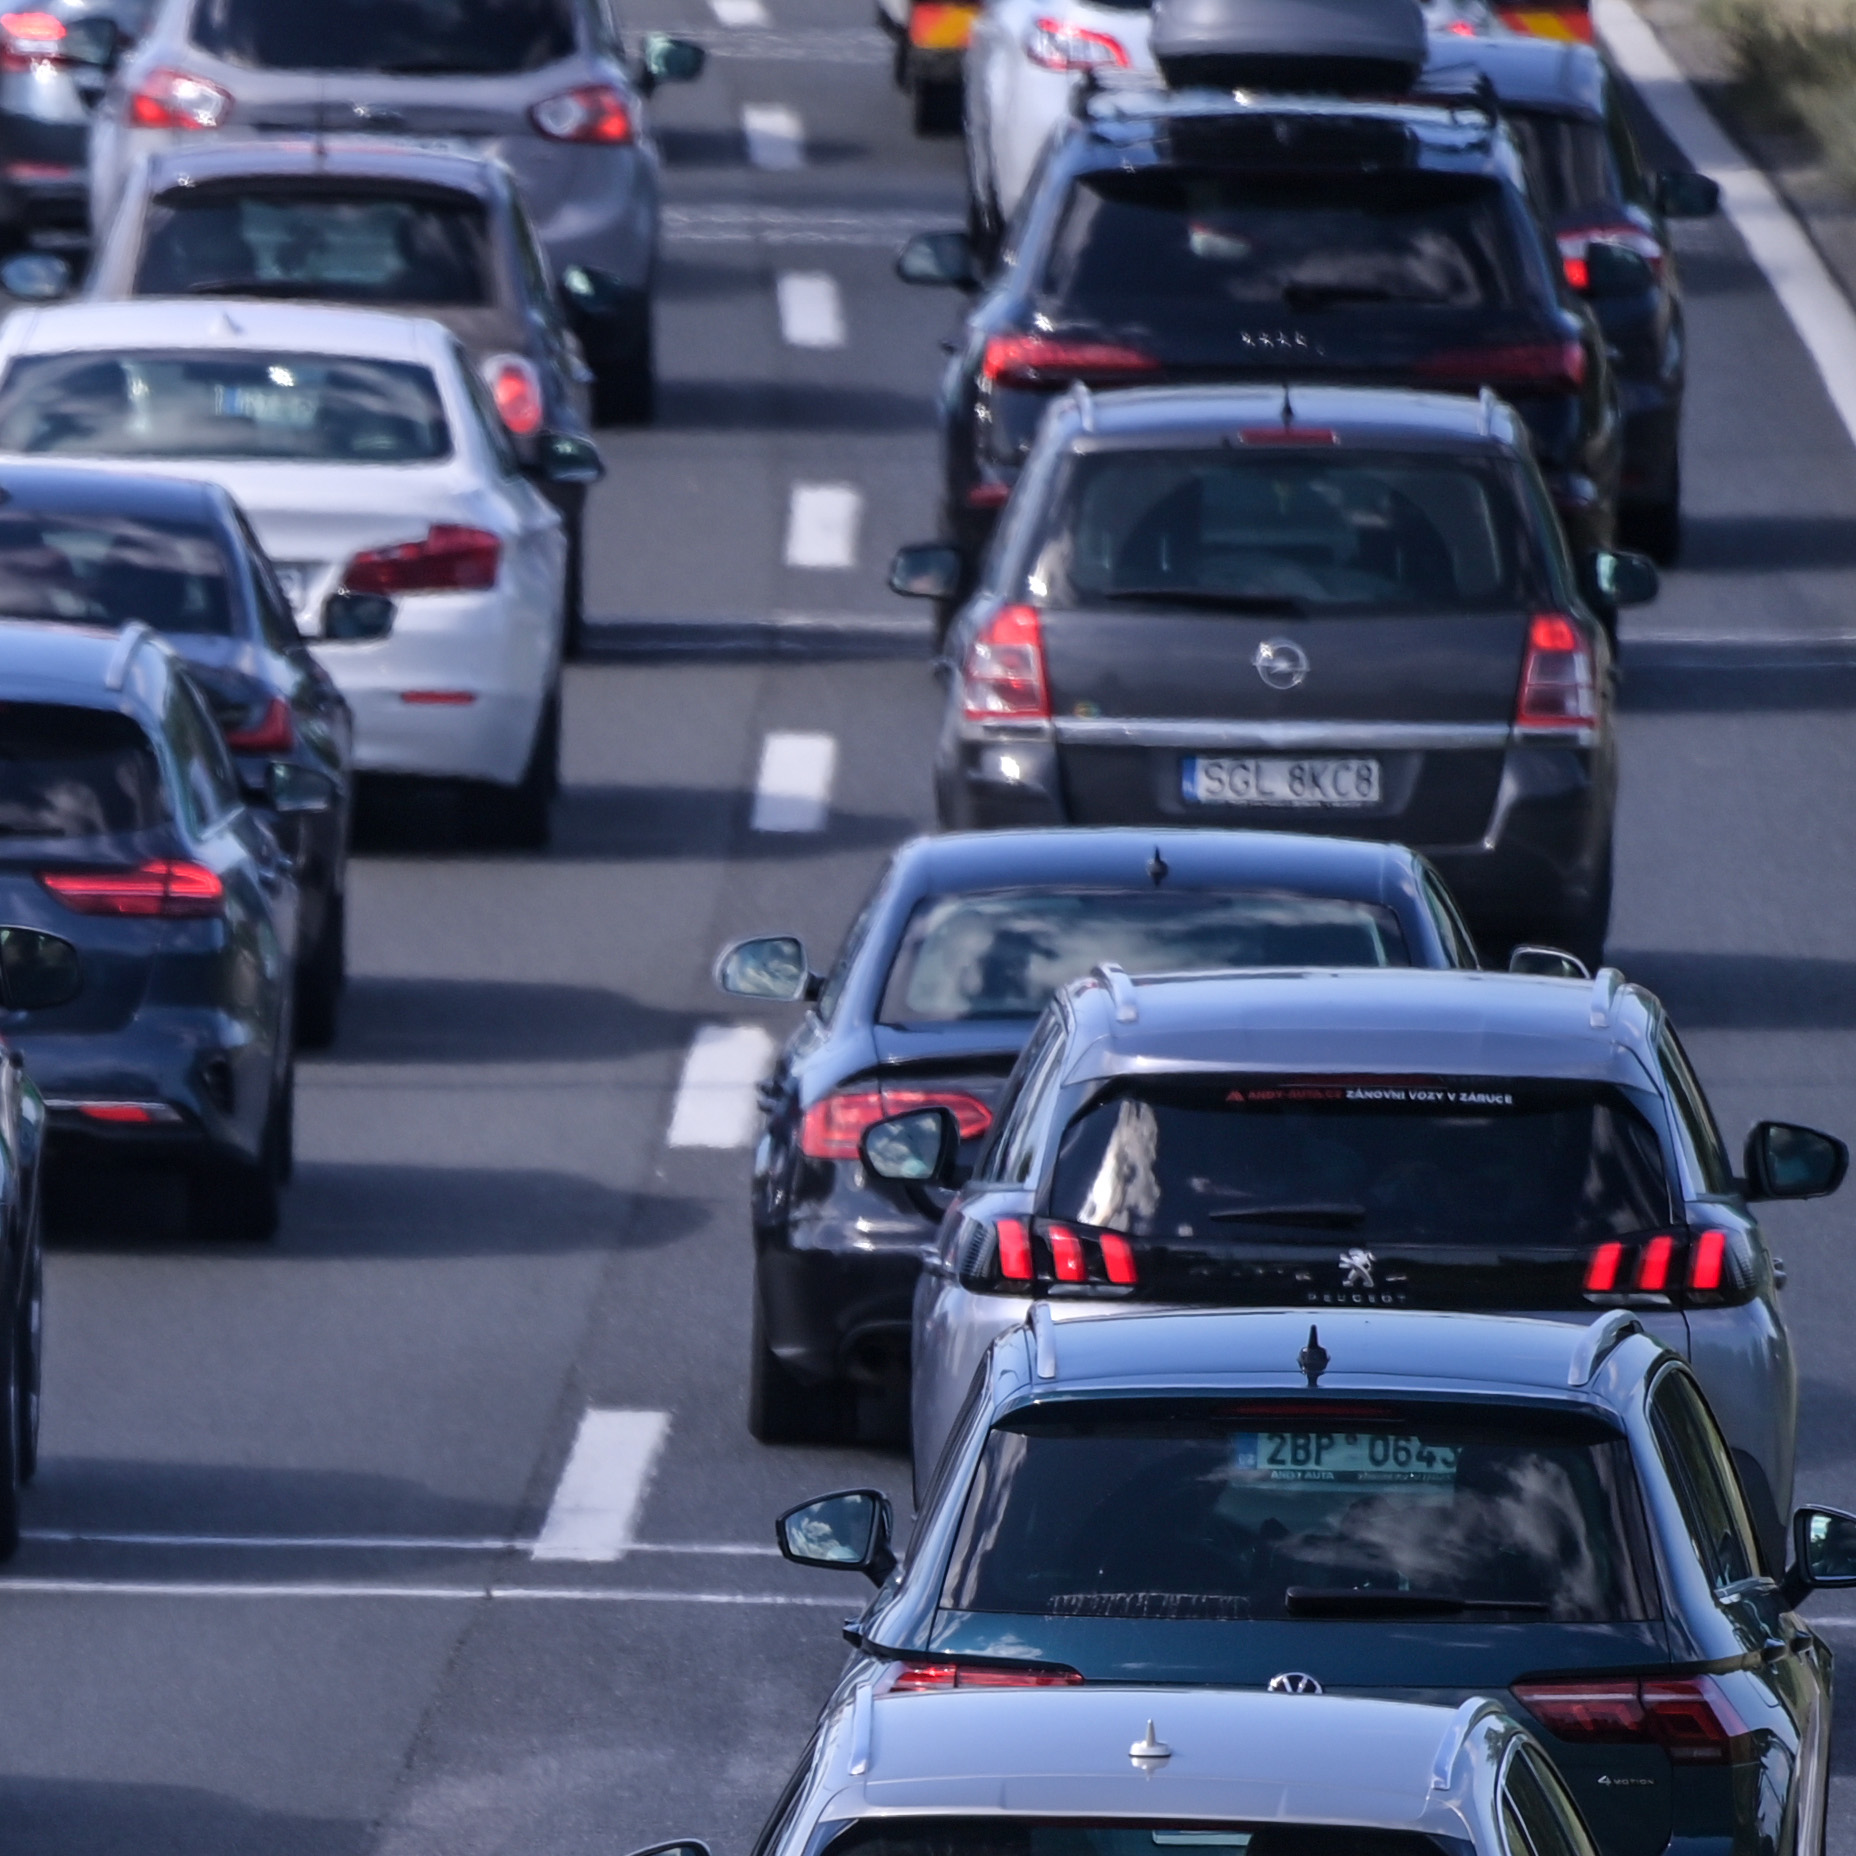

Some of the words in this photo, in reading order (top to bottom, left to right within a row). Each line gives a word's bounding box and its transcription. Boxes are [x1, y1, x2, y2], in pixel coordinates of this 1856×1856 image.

[1203, 761, 1275, 797] SGL
[1288, 763, 1373, 798] 8KC8
[1408, 1090, 1444, 1101] VOZY
[1446, 1092, 1456, 1101] V
[1307, 1293, 1407, 1303] PEUGEOT
